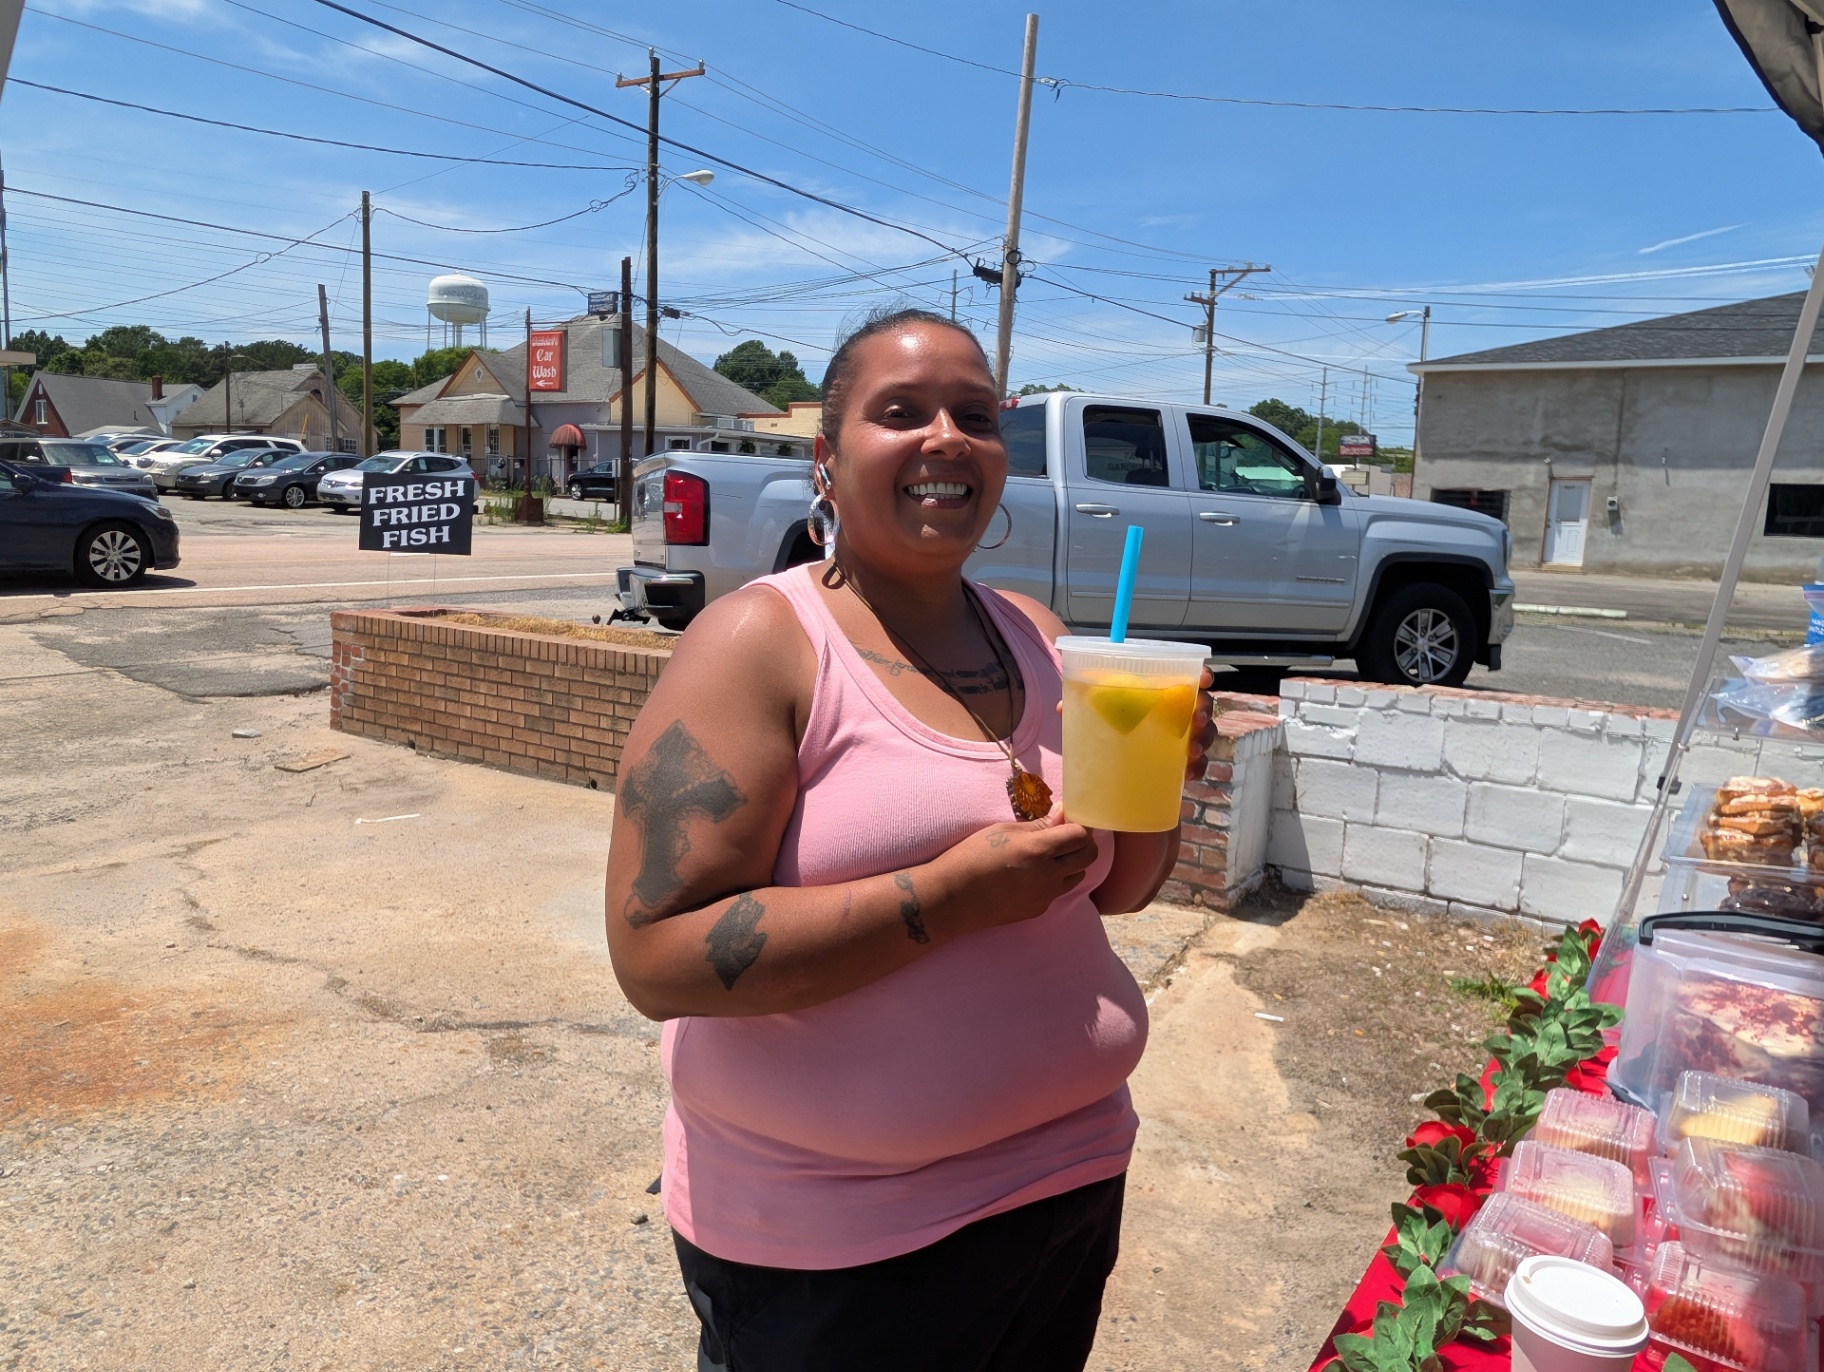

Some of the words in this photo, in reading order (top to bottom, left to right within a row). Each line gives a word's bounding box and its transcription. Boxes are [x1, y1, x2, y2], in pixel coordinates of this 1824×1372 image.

[536, 349, 553, 362] Car
[532, 365, 557, 379] Wash
[368, 480, 466, 505] FRESH
[372, 503, 461, 527] FRIED
[382, 525, 450, 548] FISH
